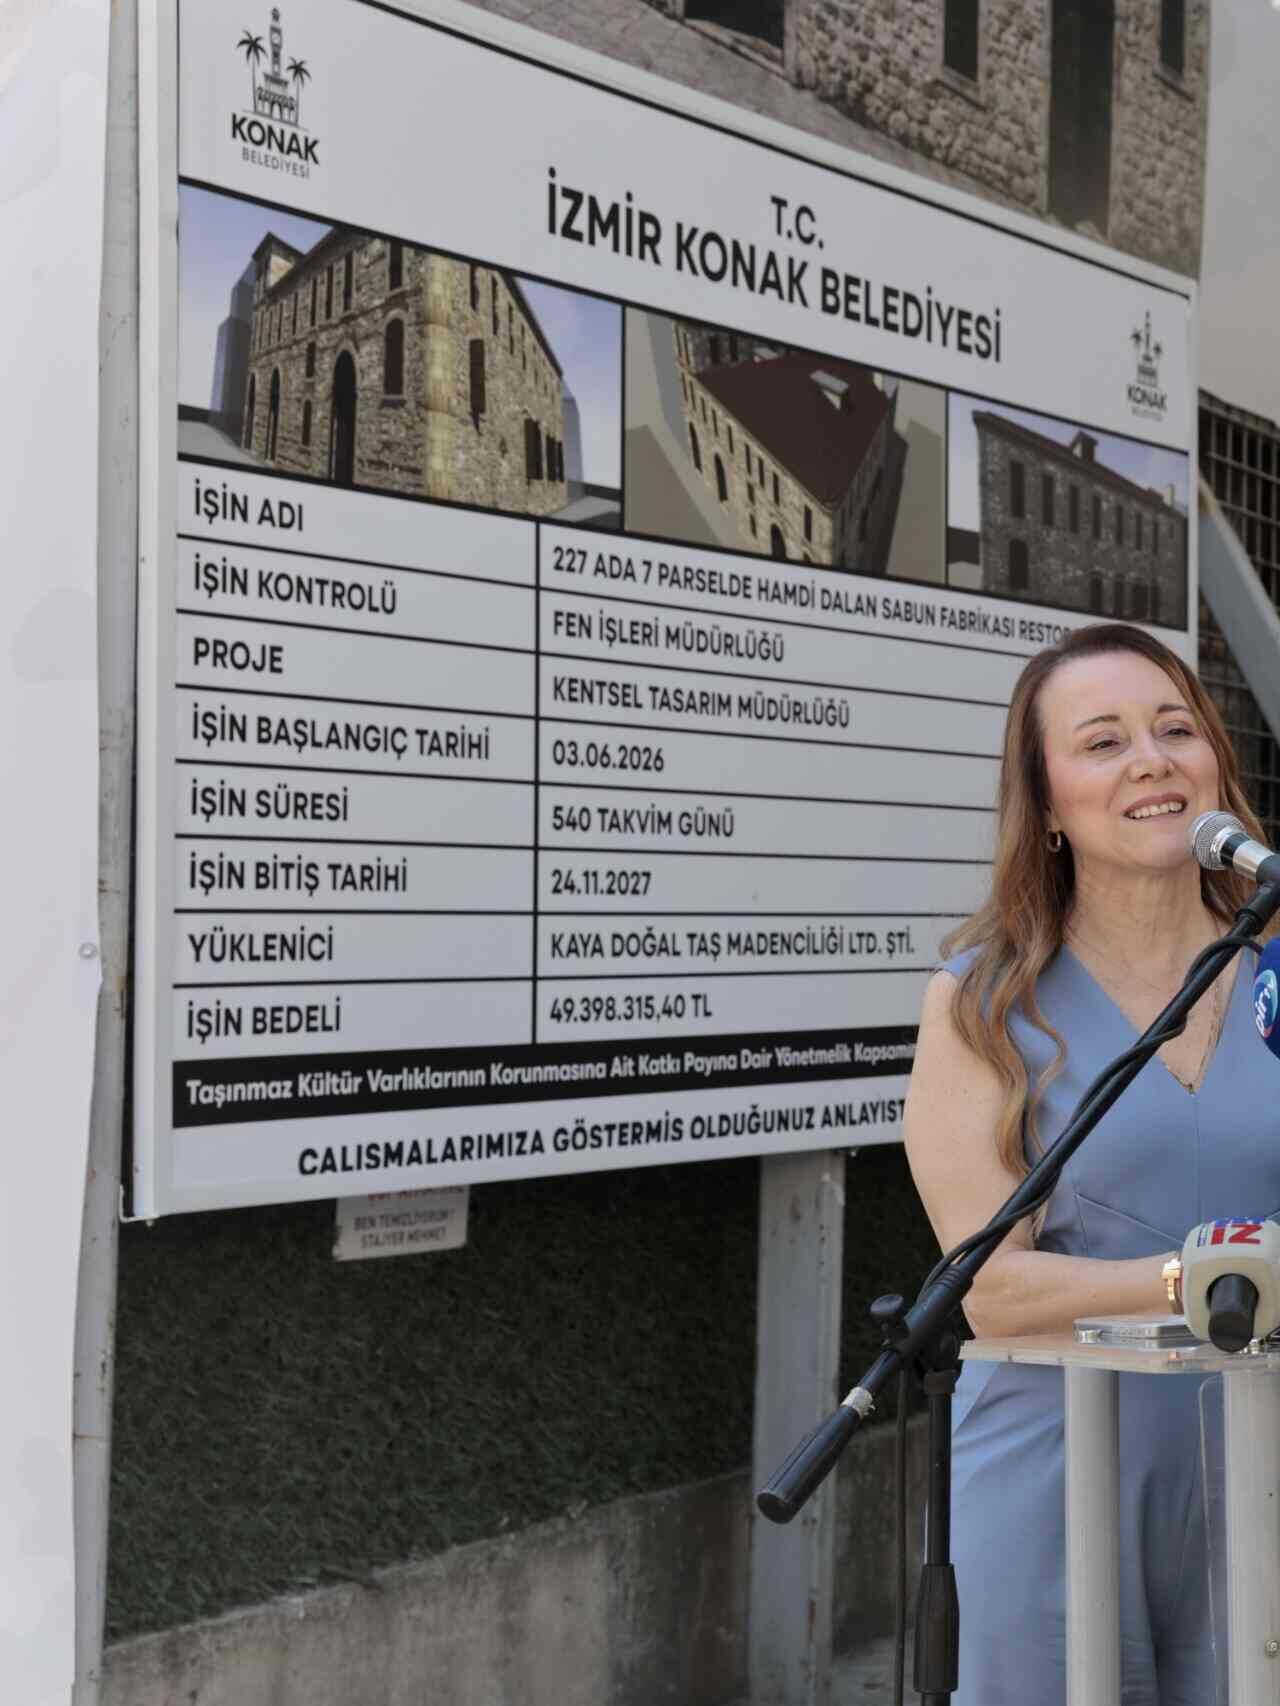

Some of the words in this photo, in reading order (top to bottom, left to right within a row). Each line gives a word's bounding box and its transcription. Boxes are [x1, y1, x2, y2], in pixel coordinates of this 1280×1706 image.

[231, 112, 320, 166] KONAK
[241, 147, 310, 179] BELEDİYESİ
[770, 195, 824, 249] T.C.
[547, 165, 662, 266] İZMİR
[675, 221, 809, 309] KONAK
[820, 266, 1002, 363] BELEDİYESİ
[194, 478, 249, 525] İŞİN
[257, 498, 304, 532] ADI
[193, 552, 249, 599] İŞİN
[257, 570, 397, 615] KONTROLÜ
[553, 545, 588, 574] 227
[593, 552, 637, 583] ADA
[642, 560, 653, 585] 7
[657, 562, 752, 599] PARSELDE
[757, 578, 816, 611] HAMDİ
[821, 587, 877, 619] DALAN
[882, 597, 936, 627] SABUN
[940, 606, 1015, 639] FABRİKASI
[192, 636, 284, 674] PROJE
[553, 610, 593, 640] FEN
[599, 608, 659, 648] İŞLERİ
[665, 621, 785, 663] MÜDÜRLÜĞÜ
[553, 675, 643, 709] KENTSEL
[648, 684, 733, 718] TASARIM
[737, 691, 850, 729] MÜDÜRLÜĞÜ
[192, 701, 248, 748] İŞİN
[256, 715, 409, 761] BAŞLANGIÇ
[415, 725, 491, 761] TARİHİ
[551, 740, 665, 773] 03.06.2026
[190, 778, 247, 823] İŞİN
[255, 783, 349, 822] SÜRESİ
[551, 805, 592, 833] 540
[597, 802, 673, 836] TAKVİM
[678, 807, 735, 838] GÜNÜ
[189, 851, 246, 896] İŞİN
[254, 853, 320, 897] BİTİŞ
[327, 857, 408, 892] TARİHİ
[550, 868, 652, 897] 24.11.2027
[188, 925, 334, 963] YÜKLENİCİ
[550, 932, 604, 960] KAYA
[611, 926, 681, 958] DOĞAL
[686, 931, 722, 963] TAŞ
[726, 926, 845, 957] MADENCİLİĞİ
[848, 931, 883, 955] LTD.
[886, 925, 915, 959] ŞTİ.
[187, 1000, 243, 1045] İŞİN
[251, 996, 342, 1036] BEDELİ
[549, 997, 686, 1024] 49.398.315,40
[690, 993, 713, 1019] TL
[186, 1079, 293, 1109] Taşınmaz
[298, 1071, 363, 1098] Kültür
[367, 1065, 486, 1094] Varlıklarının
[490, 1059, 607, 1086] Korunmasına
[610, 1058, 635, 1078] Ait
[638, 1054, 682, 1077] Katkı
[684, 1051, 738, 1078] Payına
[740, 1048, 772, 1070] Dair
[774, 1044, 852, 1068] Yönetmelik
[298, 1128, 545, 1177] CALISMALARIMIZA
[552, 1110, 684, 1153] GÖSTERMİS
[690, 1103, 816, 1140] OLDUĞUNUZ
